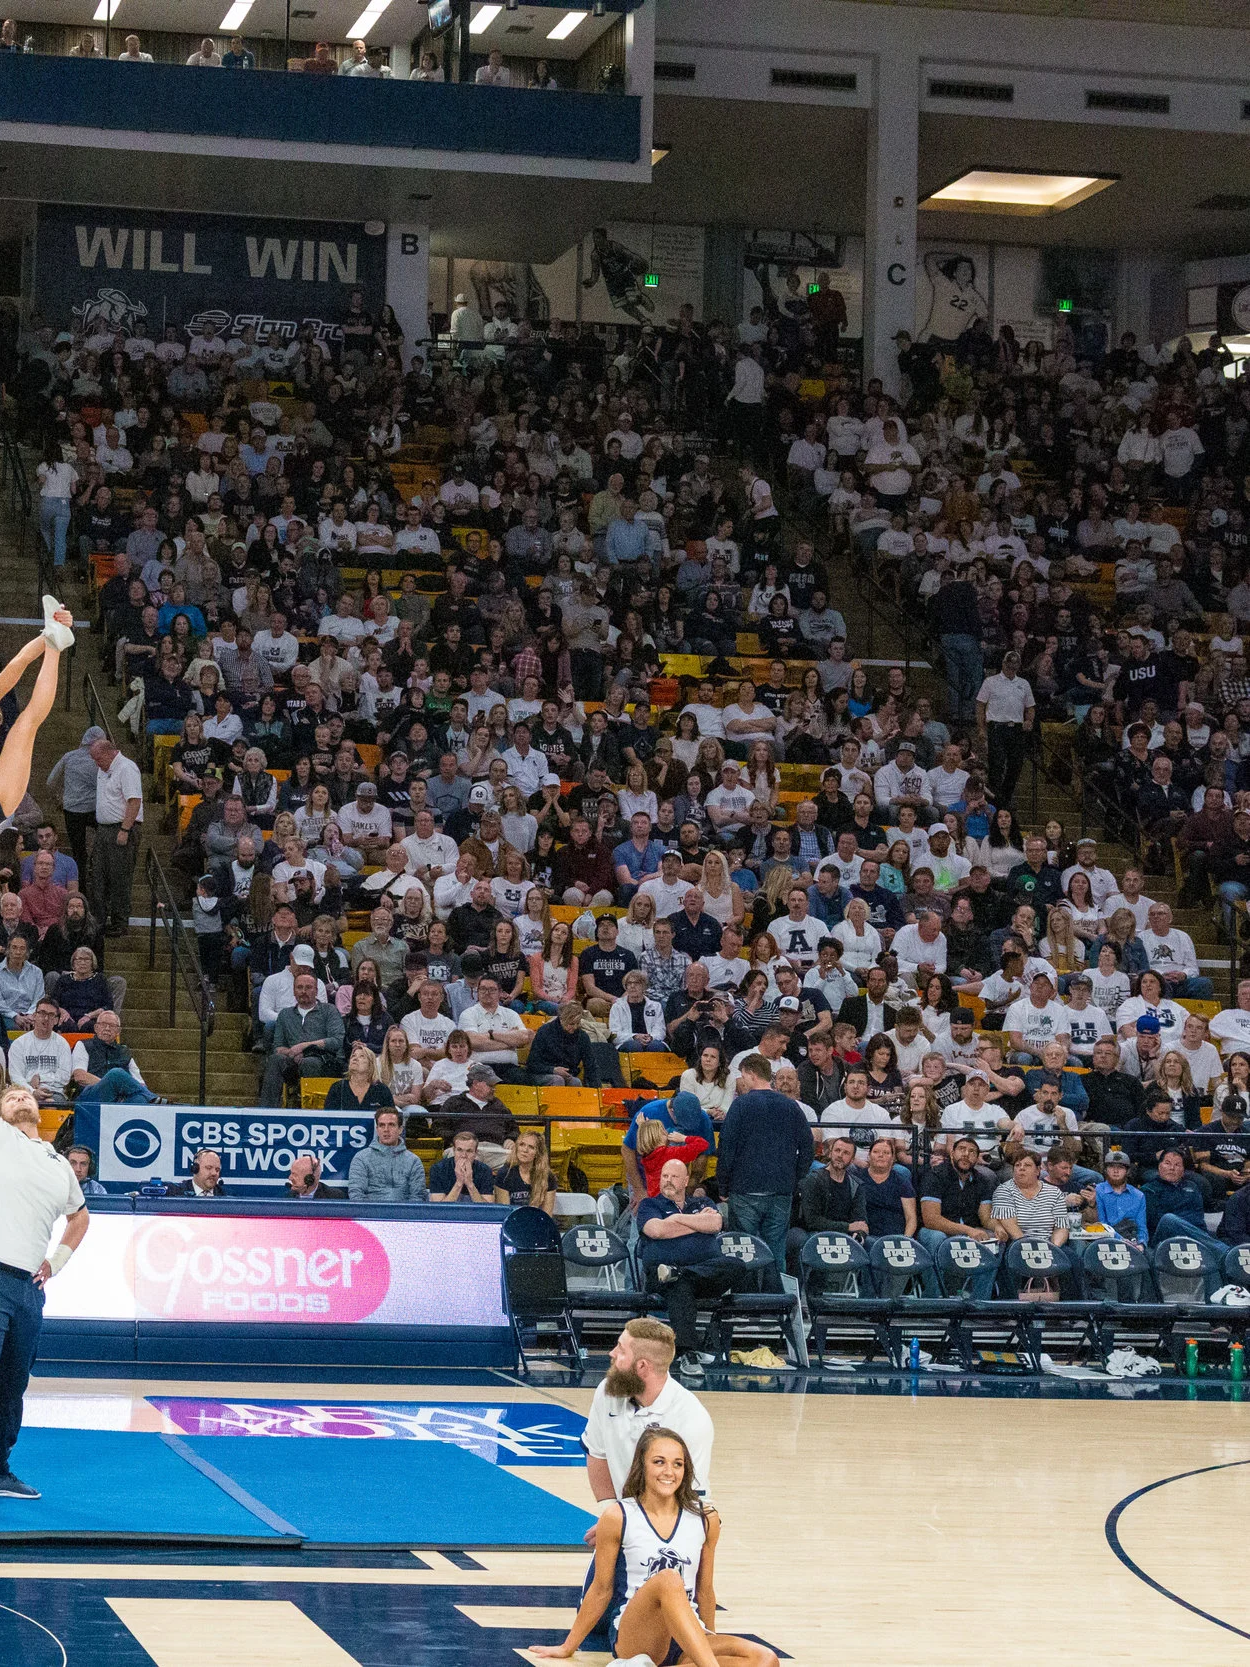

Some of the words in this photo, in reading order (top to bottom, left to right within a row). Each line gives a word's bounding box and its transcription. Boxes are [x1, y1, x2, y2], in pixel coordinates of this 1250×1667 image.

[401, 233, 420, 255] B
[74, 225, 212, 275] WILL
[245, 236, 358, 284] WIN
[645, 274, 658, 285] EXIT
[887, 263, 907, 286] C
[950, 295, 968, 310] 22
[1129, 665, 1155, 681] USU
[786, 930, 812, 952] A
[422, 1036, 444, 1044] HOOPS
[181, 1120, 240, 1145] CBS
[248, 1122, 367, 1148] SPORTS
[576, 1238, 610, 1248] STATE
[721, 1244, 756, 1254] STATE
[816, 1245, 851, 1255] STATE
[883, 1248, 916, 1259] STATE
[949, 1249, 981, 1258] STATE
[1020, 1250, 1054, 1259] STATE
[1097, 1251, 1132, 1261] STATE
[1169, 1251, 1202, 1260] STATE
[136, 1221, 363, 1313] Gossner
[202, 1291, 330, 1313] FOODS
